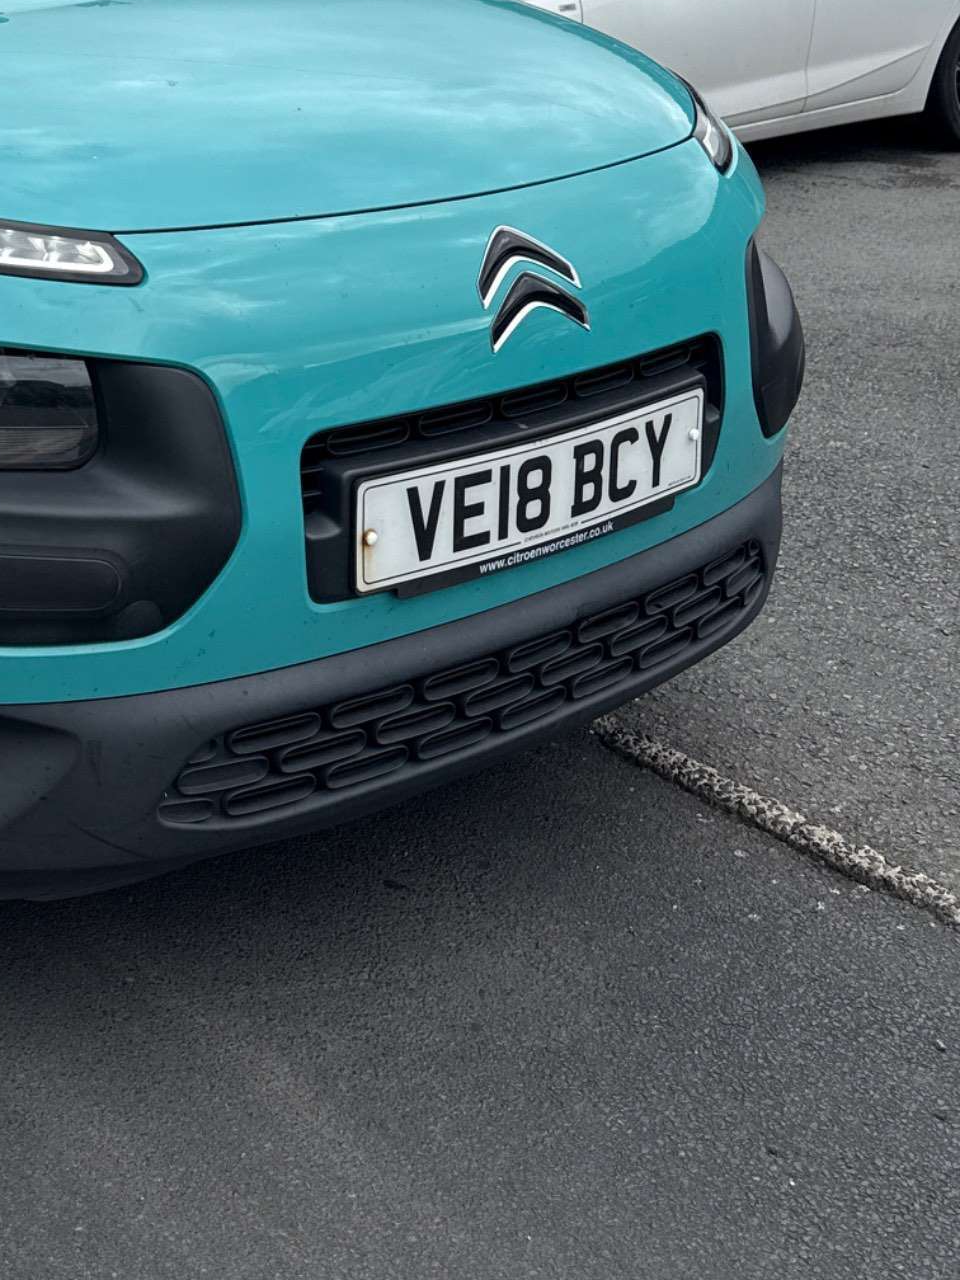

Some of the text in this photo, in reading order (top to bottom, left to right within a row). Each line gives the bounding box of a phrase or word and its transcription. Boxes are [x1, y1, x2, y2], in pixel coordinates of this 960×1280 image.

[406, 413, 673, 562] VE18 BCY
[479, 521, 614, 573] www.citroenworcester.co.uk
